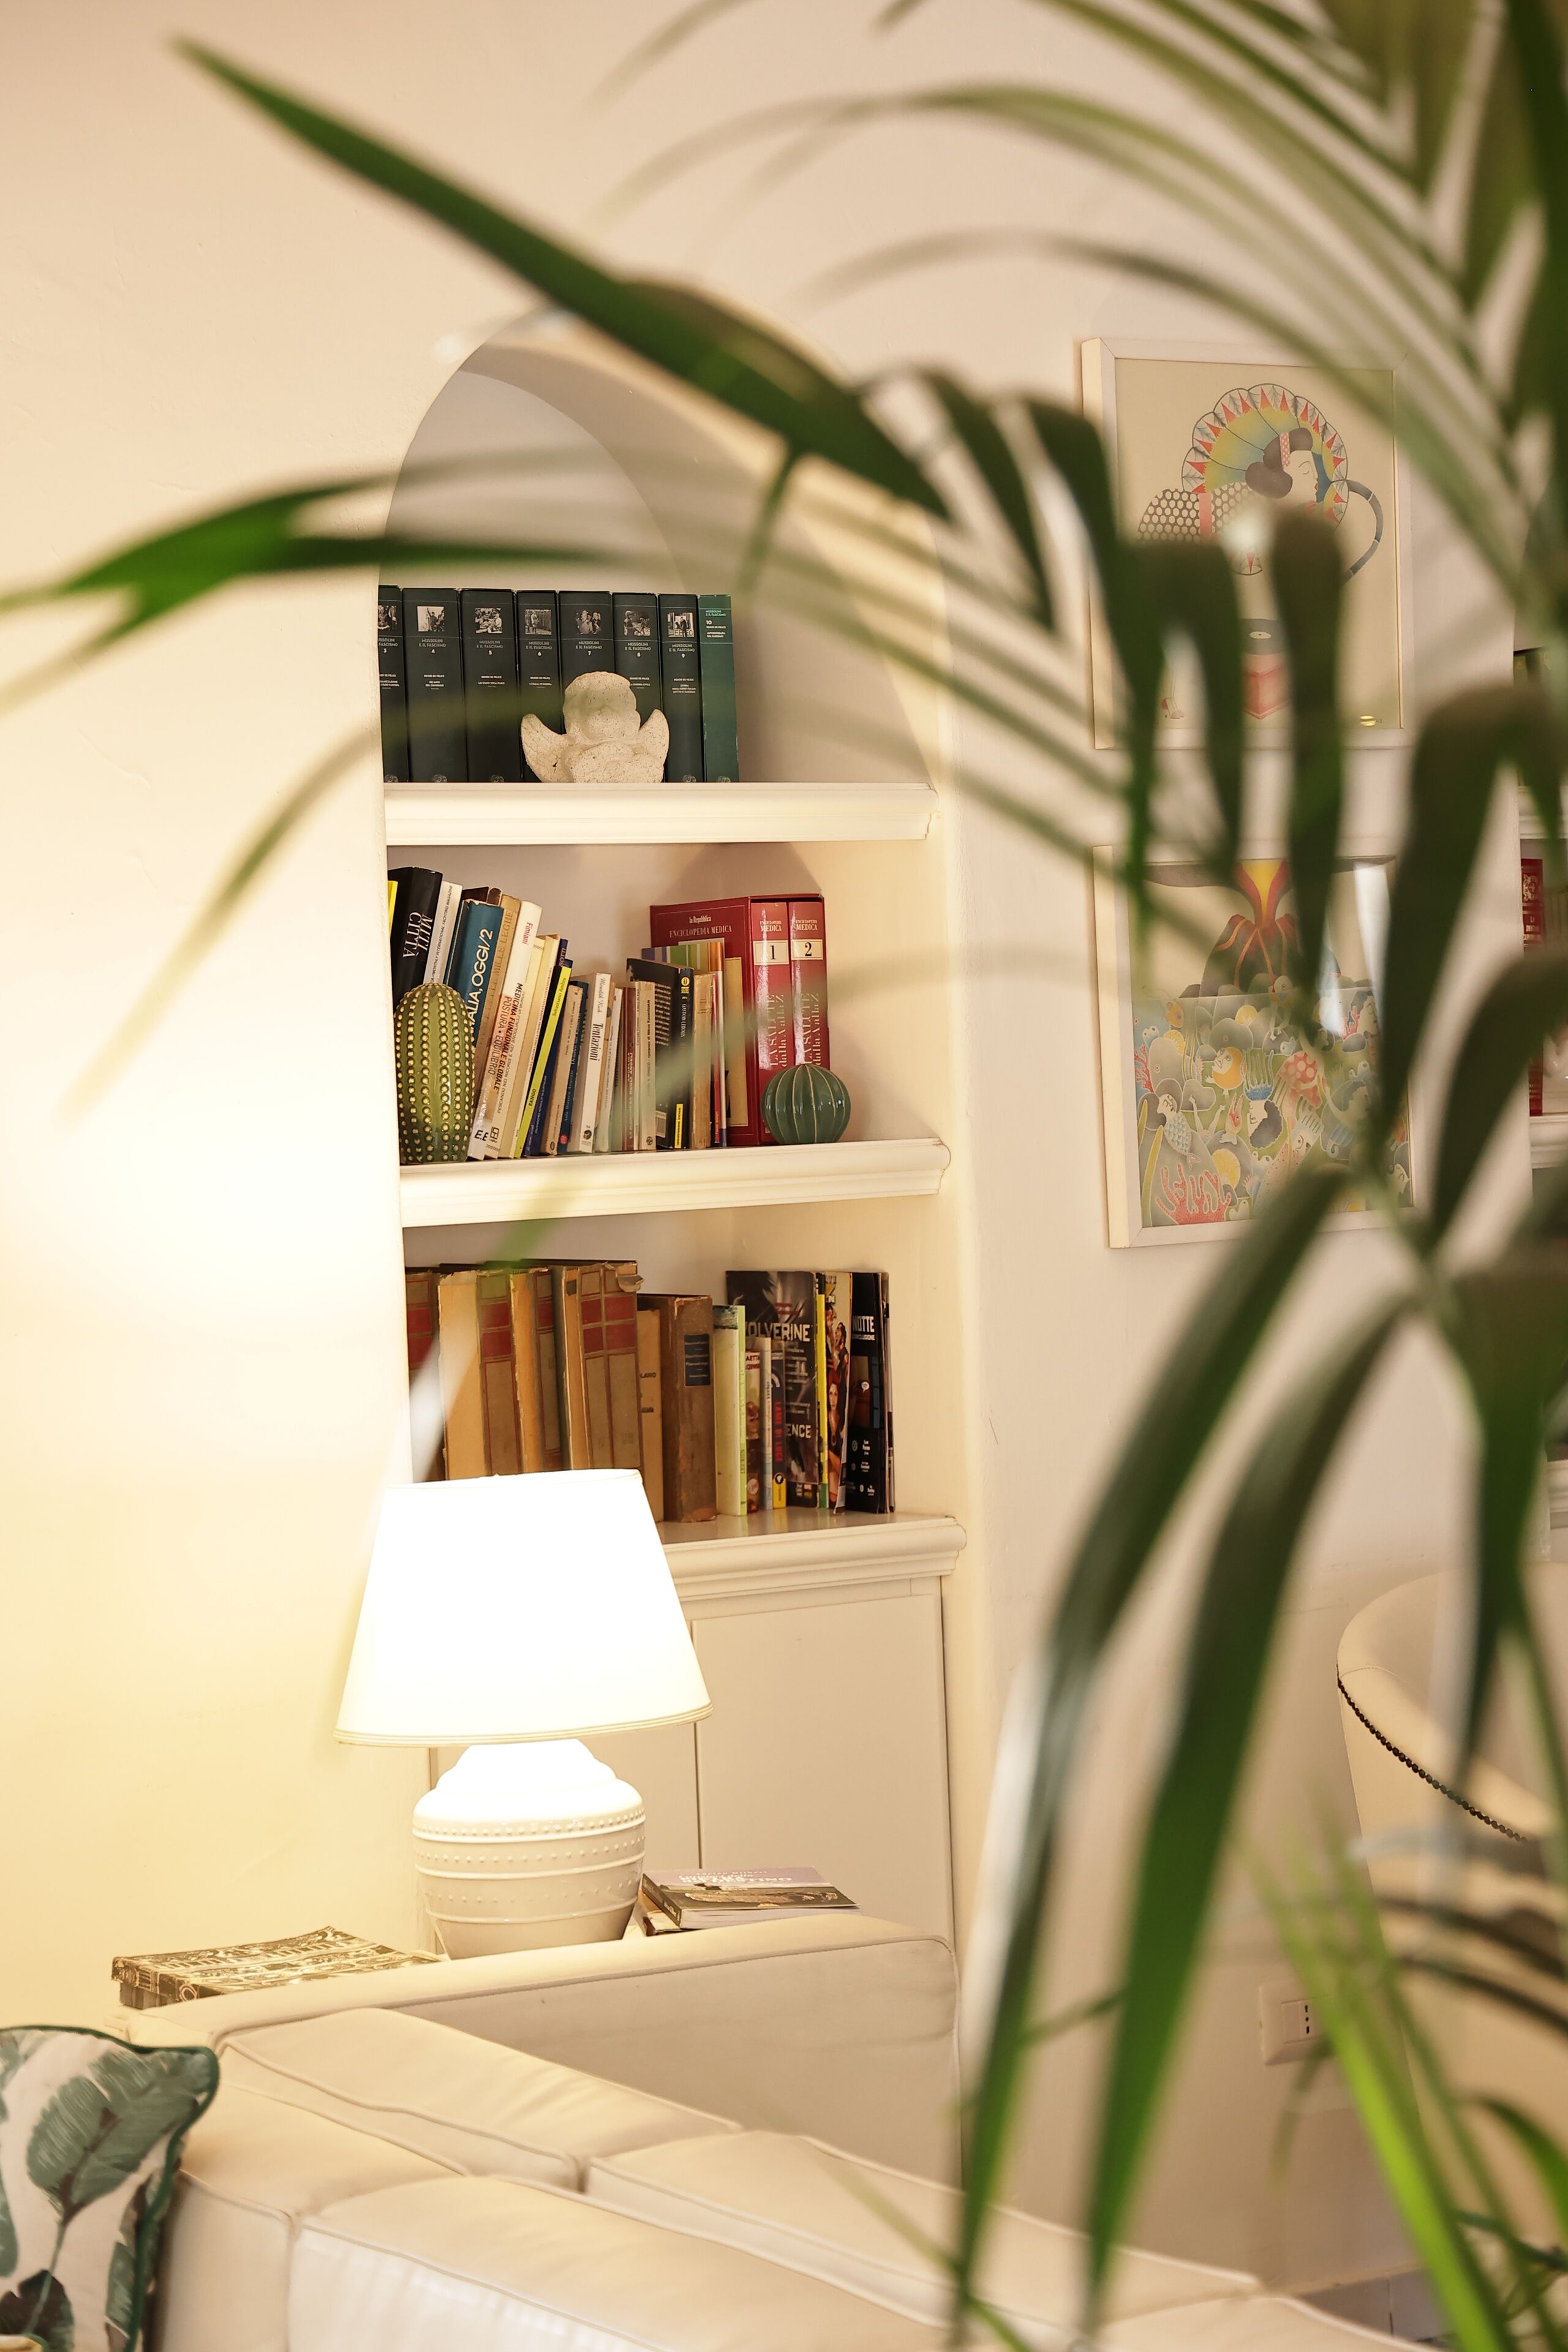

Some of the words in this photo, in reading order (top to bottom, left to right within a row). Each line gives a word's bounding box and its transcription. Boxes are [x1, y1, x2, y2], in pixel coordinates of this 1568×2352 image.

[418, 913, 433, 951] MITI
[669, 927, 710, 938] ENCICLOPEDIA
[711, 925, 732, 934] MEDICA
[693, 915, 712, 924] Repubblica
[402, 912, 422, 958] CITTÀ
[522, 922, 533, 944] Fimiani
[770, 945, 777, 960] 1
[805, 942, 812, 957] 2
[510, 983, 523, 1016] MEDICINA
[552, 993, 562, 1016] Sebastiano
[498, 997, 512, 1029] POSTURA
[766, 995, 777, 1046] SALUTE
[777, 1005, 785, 1026] alla
[801, 993, 811, 1044] SALUTE
[811, 1005, 820, 1025] alla
[500, 1016, 516, 1058] FUNZIONALE
[590, 1023, 603, 1061] Tentazioni
[488, 1035, 503, 1076] EQUILIBRIO
[769, 1049, 778, 1065] LA
[778, 1039, 787, 1067] dalla
[804, 1048, 812, 1063] LA
[494, 1056, 506, 1091] GLOBALE
[746, 1321, 810, 1342] OLVERINE
